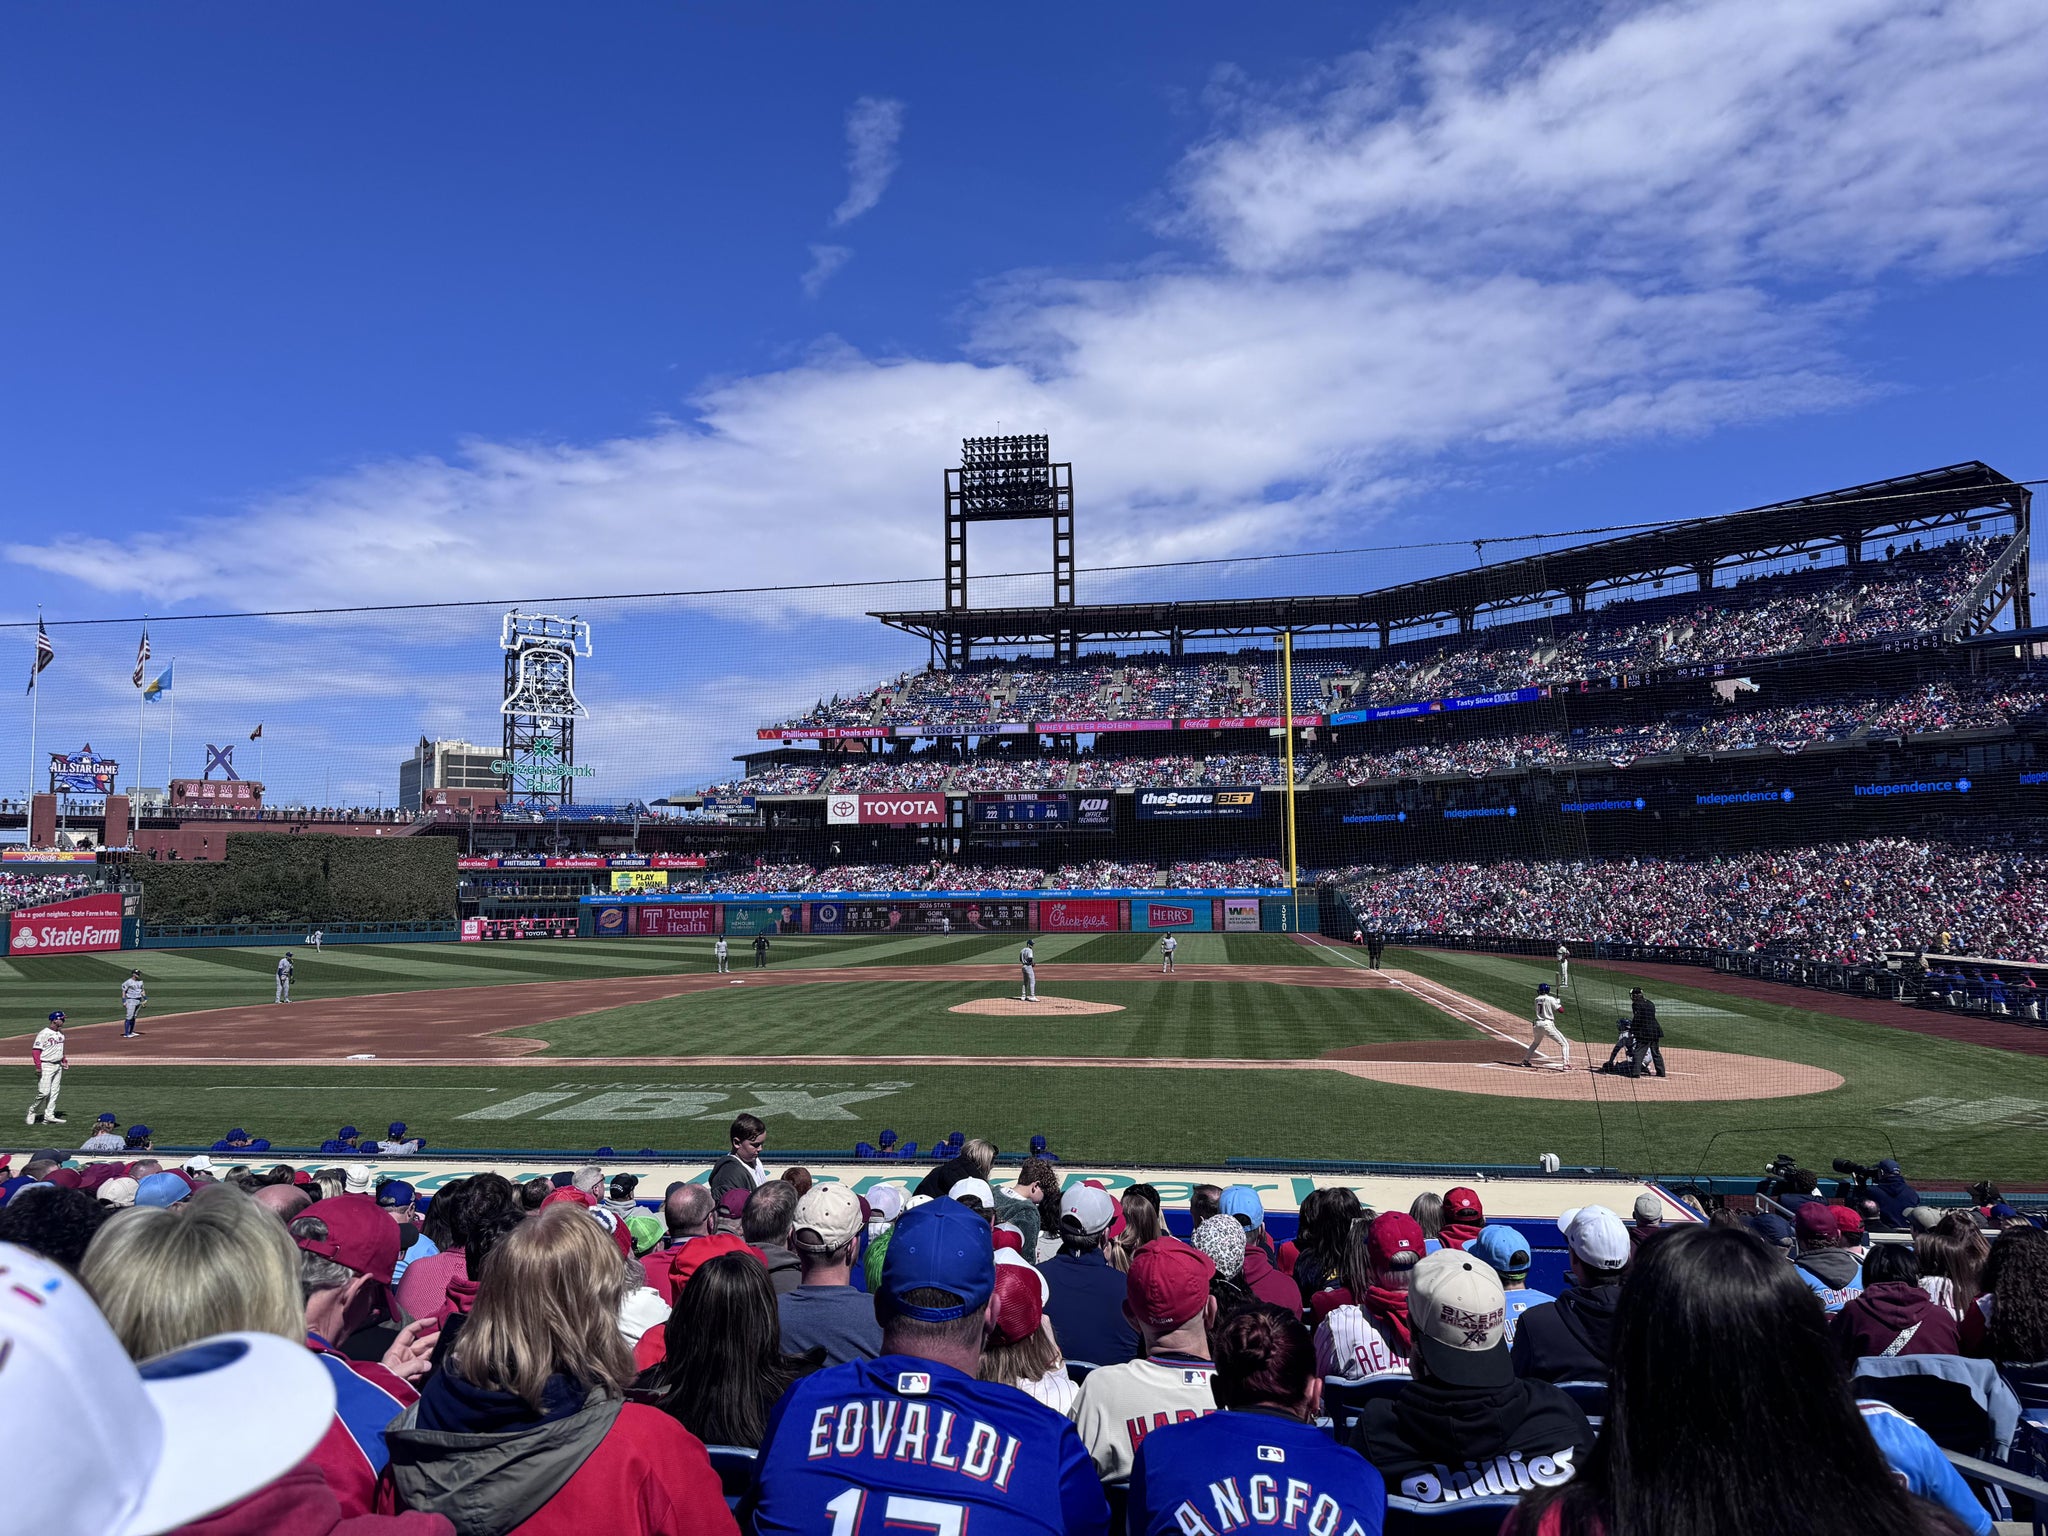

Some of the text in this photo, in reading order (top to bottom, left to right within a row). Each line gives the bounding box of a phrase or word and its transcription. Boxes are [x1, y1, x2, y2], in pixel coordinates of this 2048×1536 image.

[1456, 699, 1474, 707] Tasty
[1475, 697, 1494, 705] Since
[782, 730, 810, 738] Phillies
[922, 725, 1001, 735] LISCIO'S BAKERY
[49, 762, 118, 774] ALL STAR GAME
[490, 760, 594, 777] Citizens Bank
[526, 779, 559, 792] Park
[1854, 780, 1953, 796] Independence
[1142, 792, 1251, 805] theScore BET
[1696, 791, 1778, 806] Independence
[863, 800, 938, 816] TOYOTA
[1078, 799, 1109, 811] KDI
[1561, 800, 1632, 813] Independence
[1343, 813, 1396, 823] Independence
[1444, 807, 1506, 819] Independence
[22, 853, 57, 862] Surfside
[32, 911, 46, 919] good
[666, 908, 709, 922] Temple
[1049, 903, 1109, 928] Chick-fil-A
[1153, 910, 1188, 922] HERR'S
[1228, 907, 1256, 915] WM
[667, 922, 706, 933] Health
[305, 934, 316, 944] 40
[547, 1082, 855, 1091] Independence
[453, 1091, 901, 1120] IBX
[808, 1400, 1022, 1493] EOVALDI
[1401, 1446, 1576, 1503] Phillies
